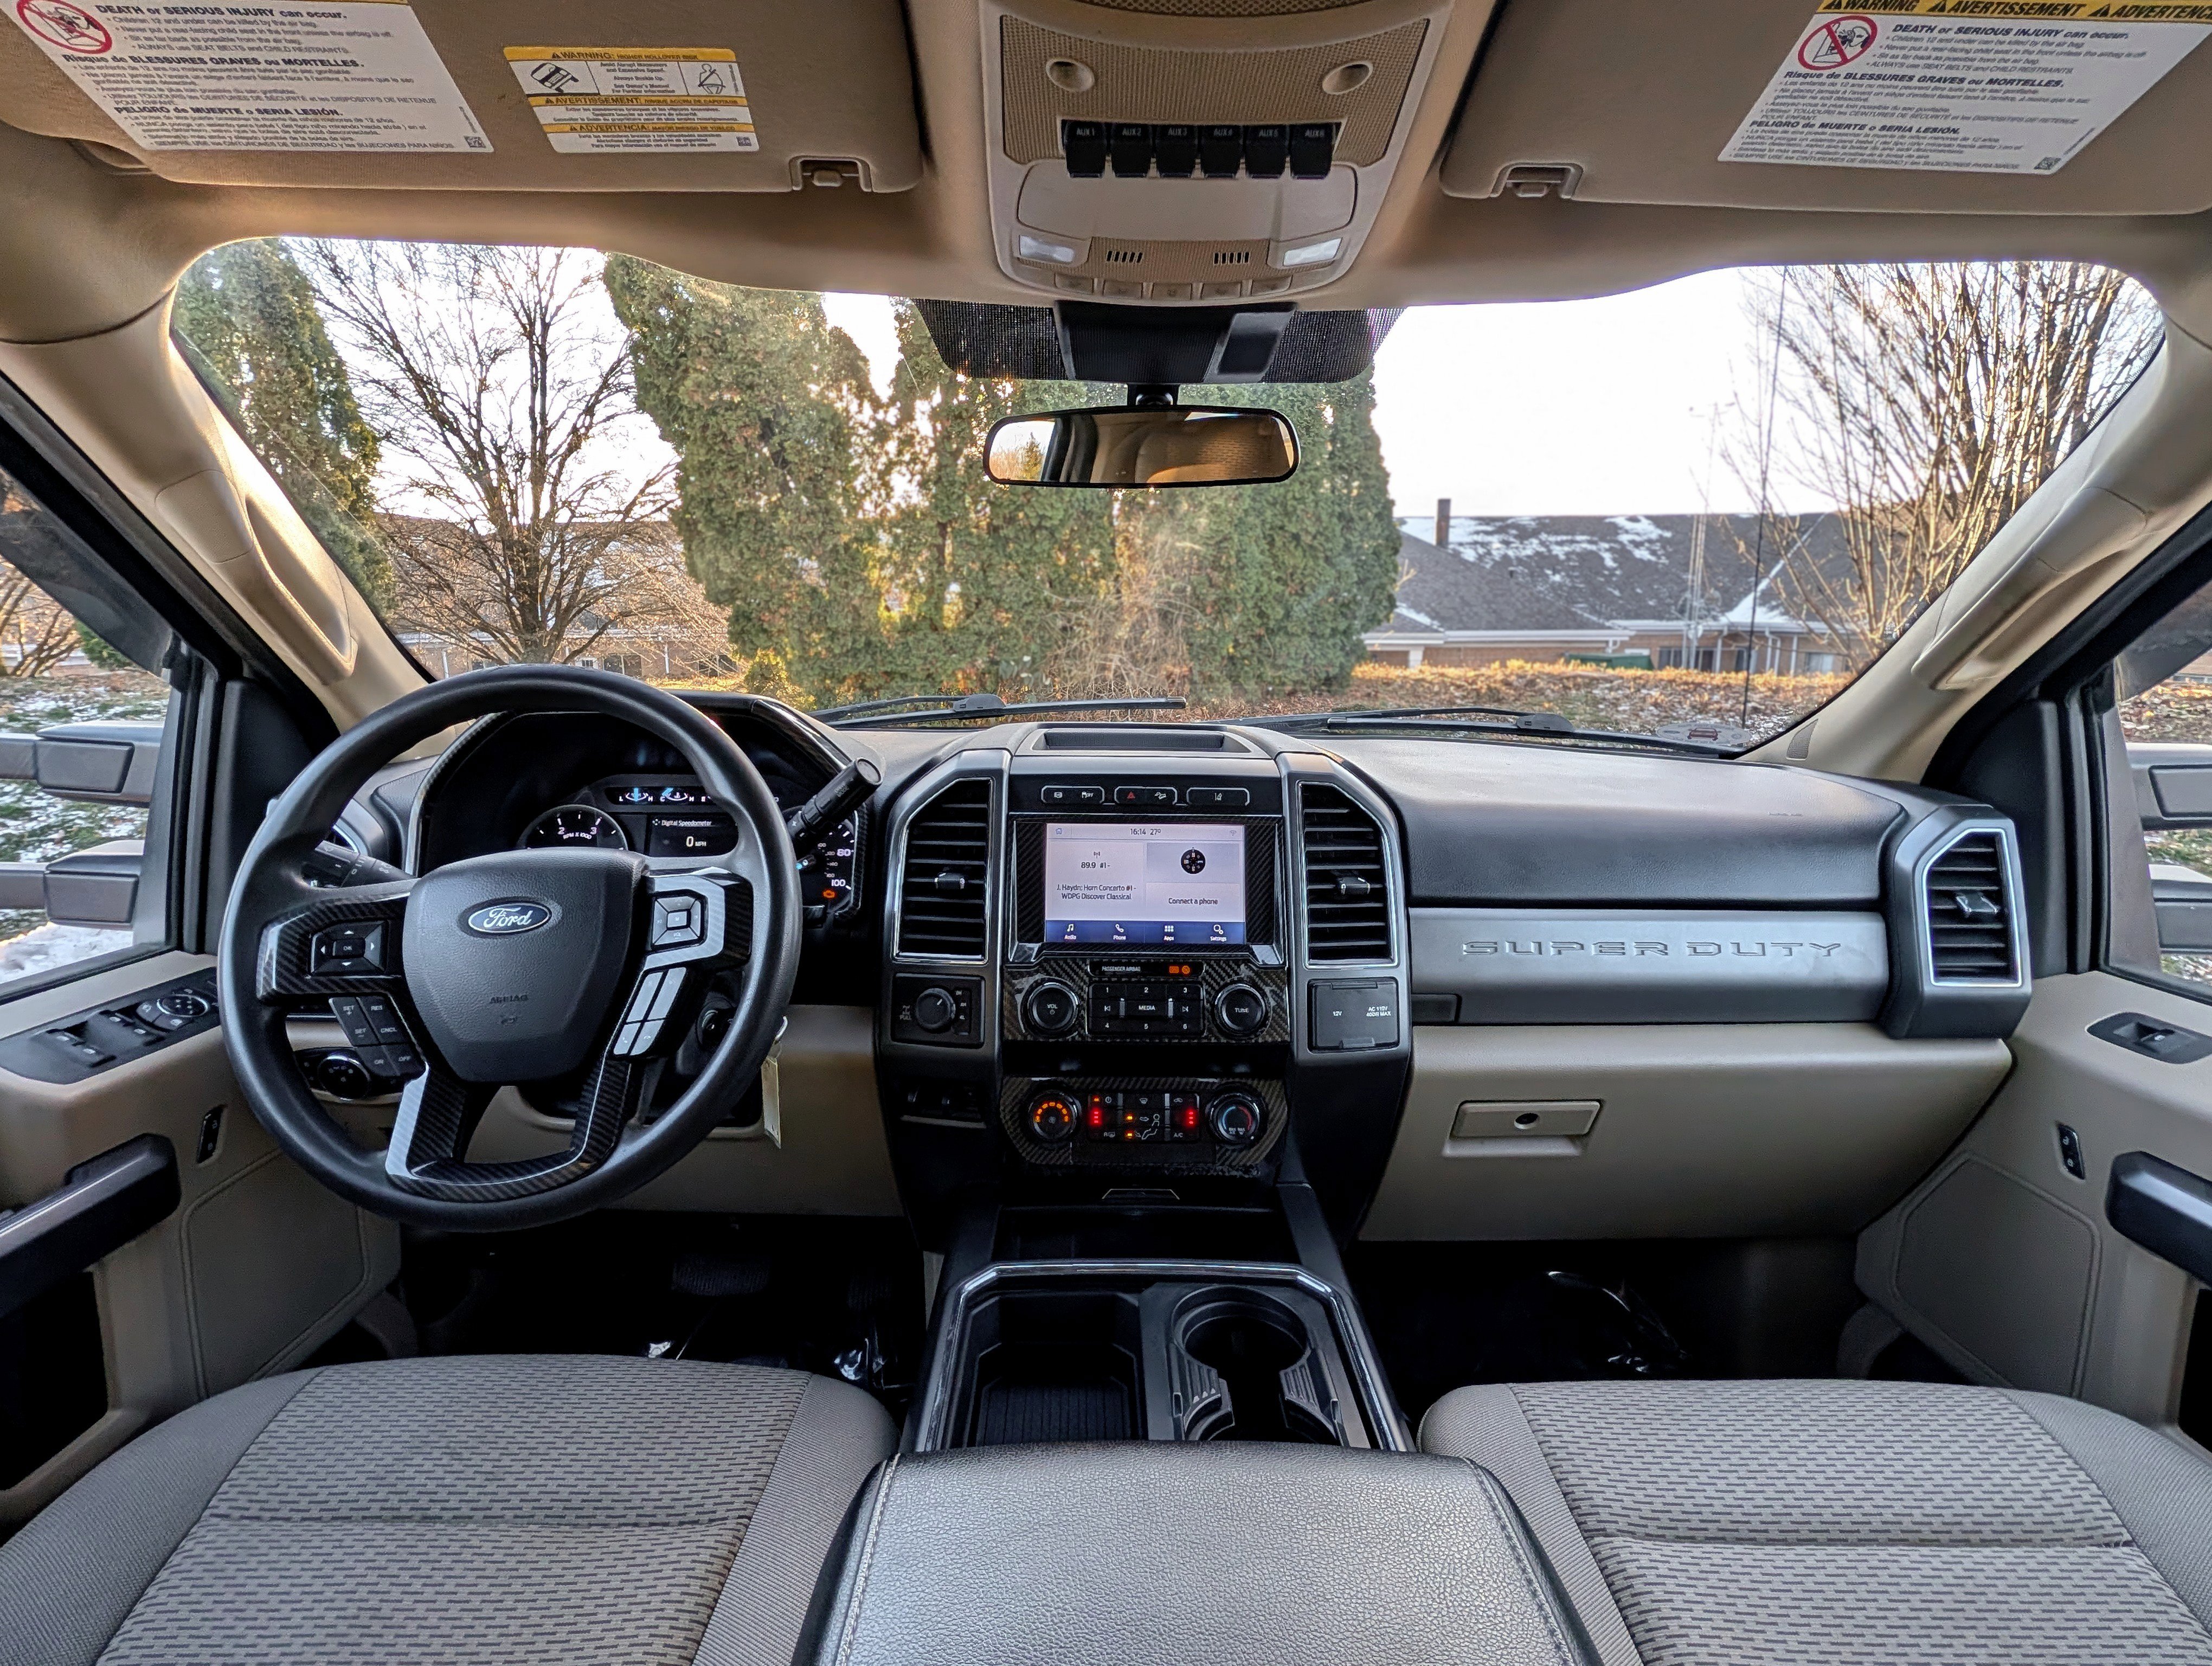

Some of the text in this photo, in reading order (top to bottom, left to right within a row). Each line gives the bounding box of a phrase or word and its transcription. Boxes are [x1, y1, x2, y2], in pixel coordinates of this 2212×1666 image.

[95, 5, 145, 15] DEATH
[163, 7, 225, 15] SERIOUS
[226, 7, 275, 17] INJURY
[280, 10, 304, 18] can
[306, 11, 348, 19] occur.
[1844, 0, 1920, 11] WARNING
[1947, 1, 2087, 17] AVERTISSEMENT
[1892, 24, 1938, 33] DEATH
[1954, 26, 2013, 36] SERIOUS
[2014, 28, 2064, 37] INJURY
[128, 55, 208, 65] BLESSURES
[209, 57, 261, 67] GRAVES
[281, 58, 365, 68] MORTELLES.
[1784, 71, 1824, 79] Risque
[1843, 73, 1916, 82] BLESSURES
[1917, 75, 1966, 85] GRAVES
[1985, 78, 2064, 87] MORTELLES.
[1122, 127, 1136, 136] AUX
[1168, 127, 1188, 136] AUX 3
[1213, 128, 1227, 137] AUX
[1259, 129, 1274, 137] AUX
[1305, 129, 1320, 137] AUX
[1818, 122, 1868, 130] MUERTE
[1879, 125, 1914, 133] SERIA
[686, 836, 694, 847] 0
[483, 907, 533, 928] Ford
[1463, 941, 1842, 958] SUPER DUTY
